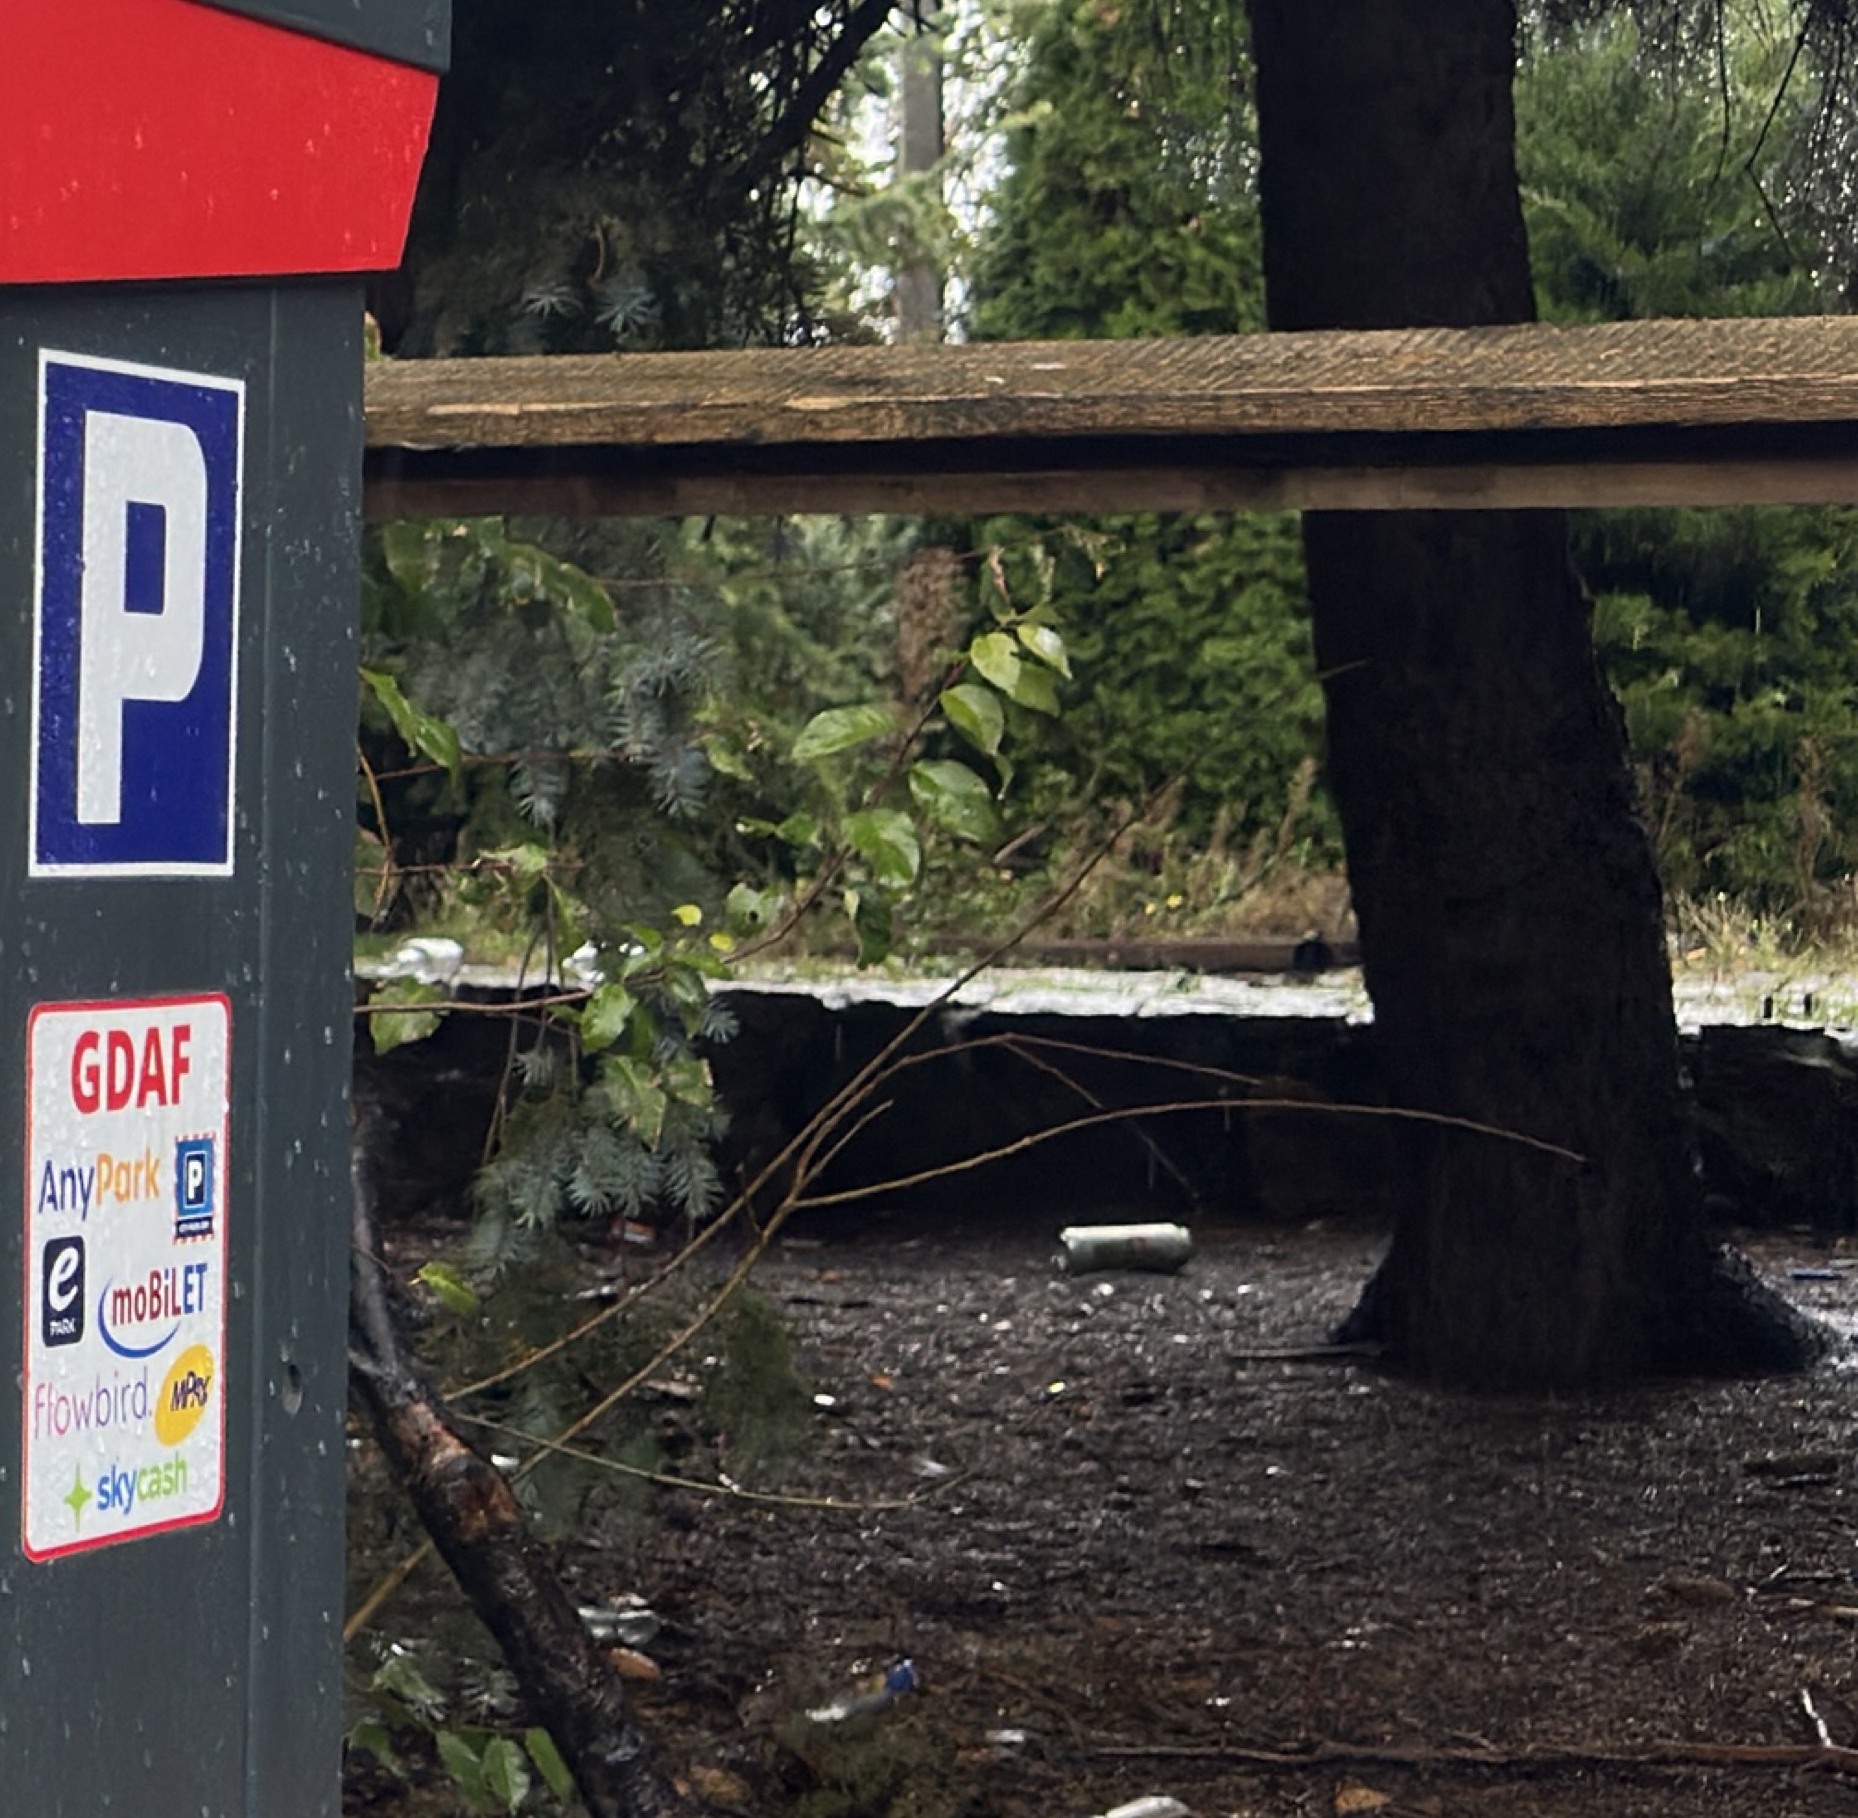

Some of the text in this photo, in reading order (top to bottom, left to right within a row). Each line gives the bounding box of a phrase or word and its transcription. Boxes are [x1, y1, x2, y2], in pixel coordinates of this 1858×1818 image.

[76, 409, 207, 824] P
[71, 1024, 191, 1115] GDAF
[38, 1146, 160, 1222] AnyPark
[187, 1159, 203, 1200] P
[96, 1450, 189, 1516] skycash
